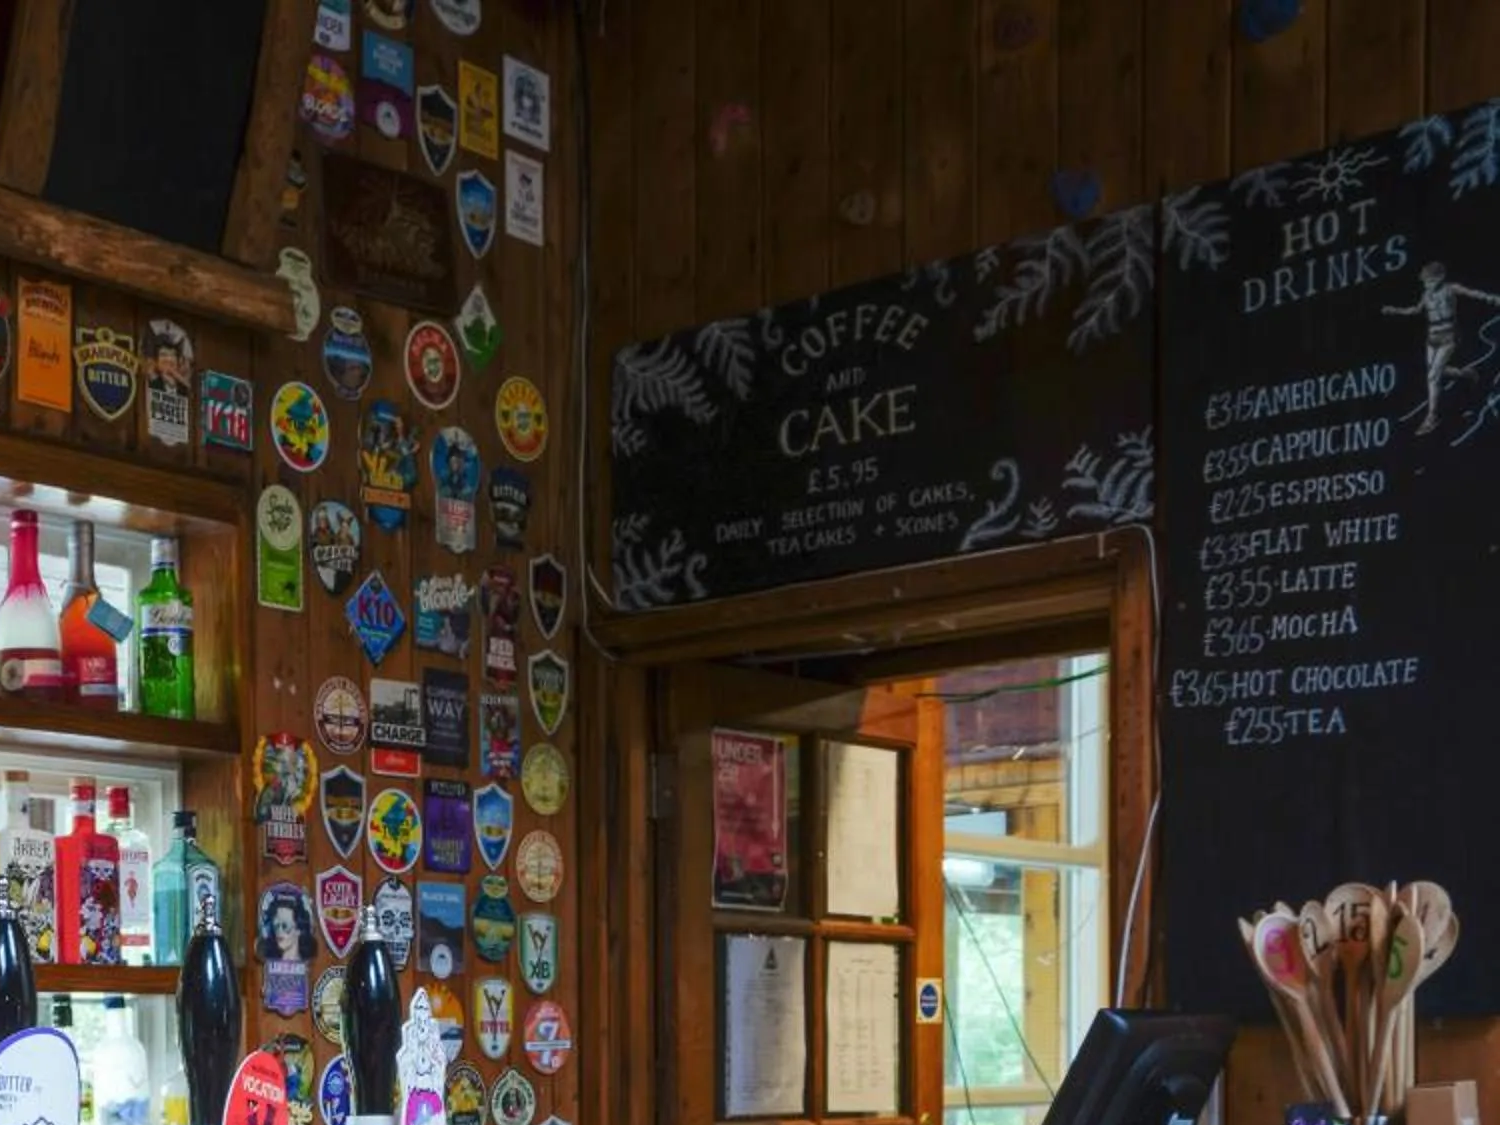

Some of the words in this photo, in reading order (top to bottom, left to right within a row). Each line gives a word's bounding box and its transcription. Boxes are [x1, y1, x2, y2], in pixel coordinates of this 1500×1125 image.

[1282, 198, 1377, 259] HOT
[1241, 234, 1408, 313] DRINKS
[781, 302, 931, 377] COFFEE
[826, 366, 865, 394] AND
[1252, 363, 1396, 419] AMERICANO
[780, 384, 917, 457] CAKE
[1252, 417, 1390, 466] CAPPUCINO
[806, 457, 879, 495] £5.95
[1270, 469, 1385, 508] ESPRESSO
[716, 517, 765, 544] DAILY
[781, 496, 864, 531] SELECTION
[875, 494, 898, 515] OF
[894, 511, 960, 538] SCONES
[1250, 523, 1310, 558] FLAT
[1325, 512, 1399, 548] WHITE
[1281, 562, 1359, 594] LATTE
[1270, 605, 1359, 642] MOCHA
[1231, 669, 1284, 701] HOT
[1291, 657, 1419, 694] CHOCOLATE
[427, 699, 465, 721] WAY
[1283, 707, 1347, 737] TEA
[373, 724, 425, 745] CHARGE
[716, 738, 764, 764] UNDER
